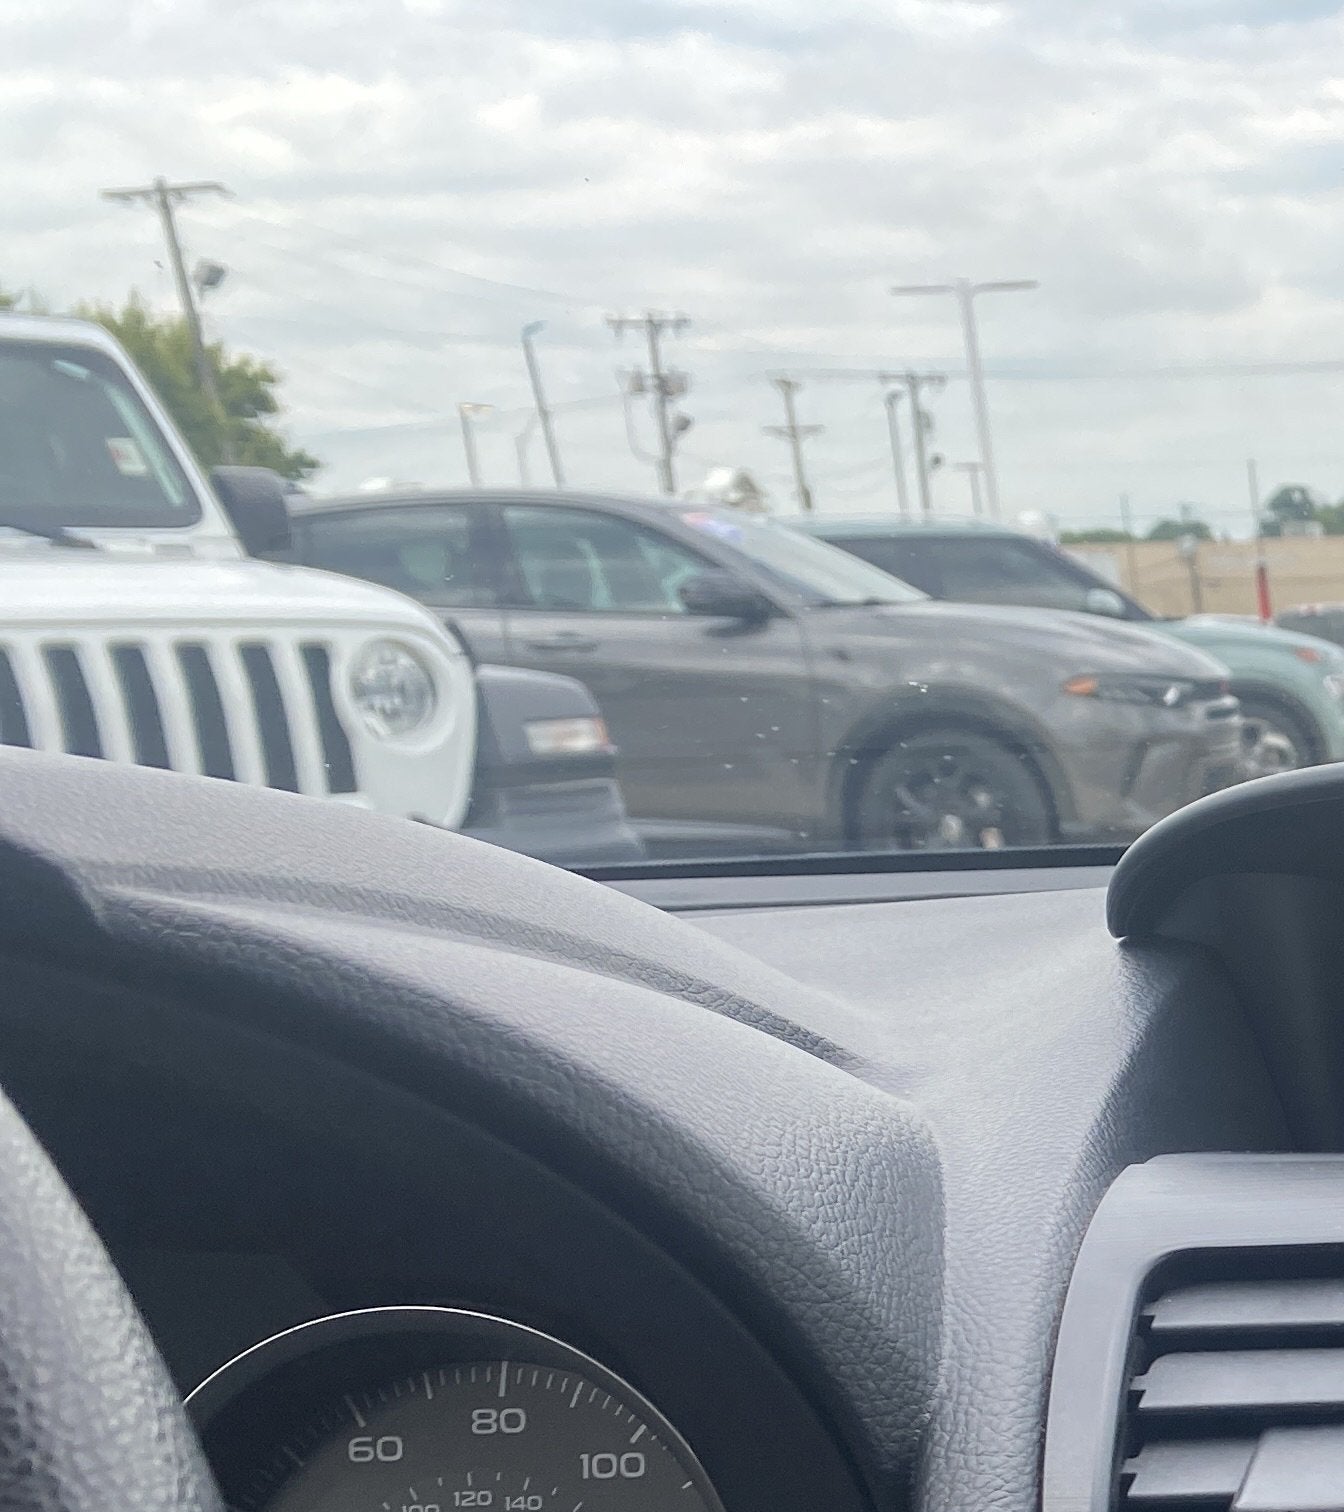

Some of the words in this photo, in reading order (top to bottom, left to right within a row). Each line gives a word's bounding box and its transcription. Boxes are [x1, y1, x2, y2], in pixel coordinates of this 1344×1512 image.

[471, 1407, 527, 1435] 80
[348, 1435, 403, 1463] 60
[579, 1452, 646, 1479] 100
[453, 1490, 493, 1507] 120
[504, 1495, 543, 1512] 140
